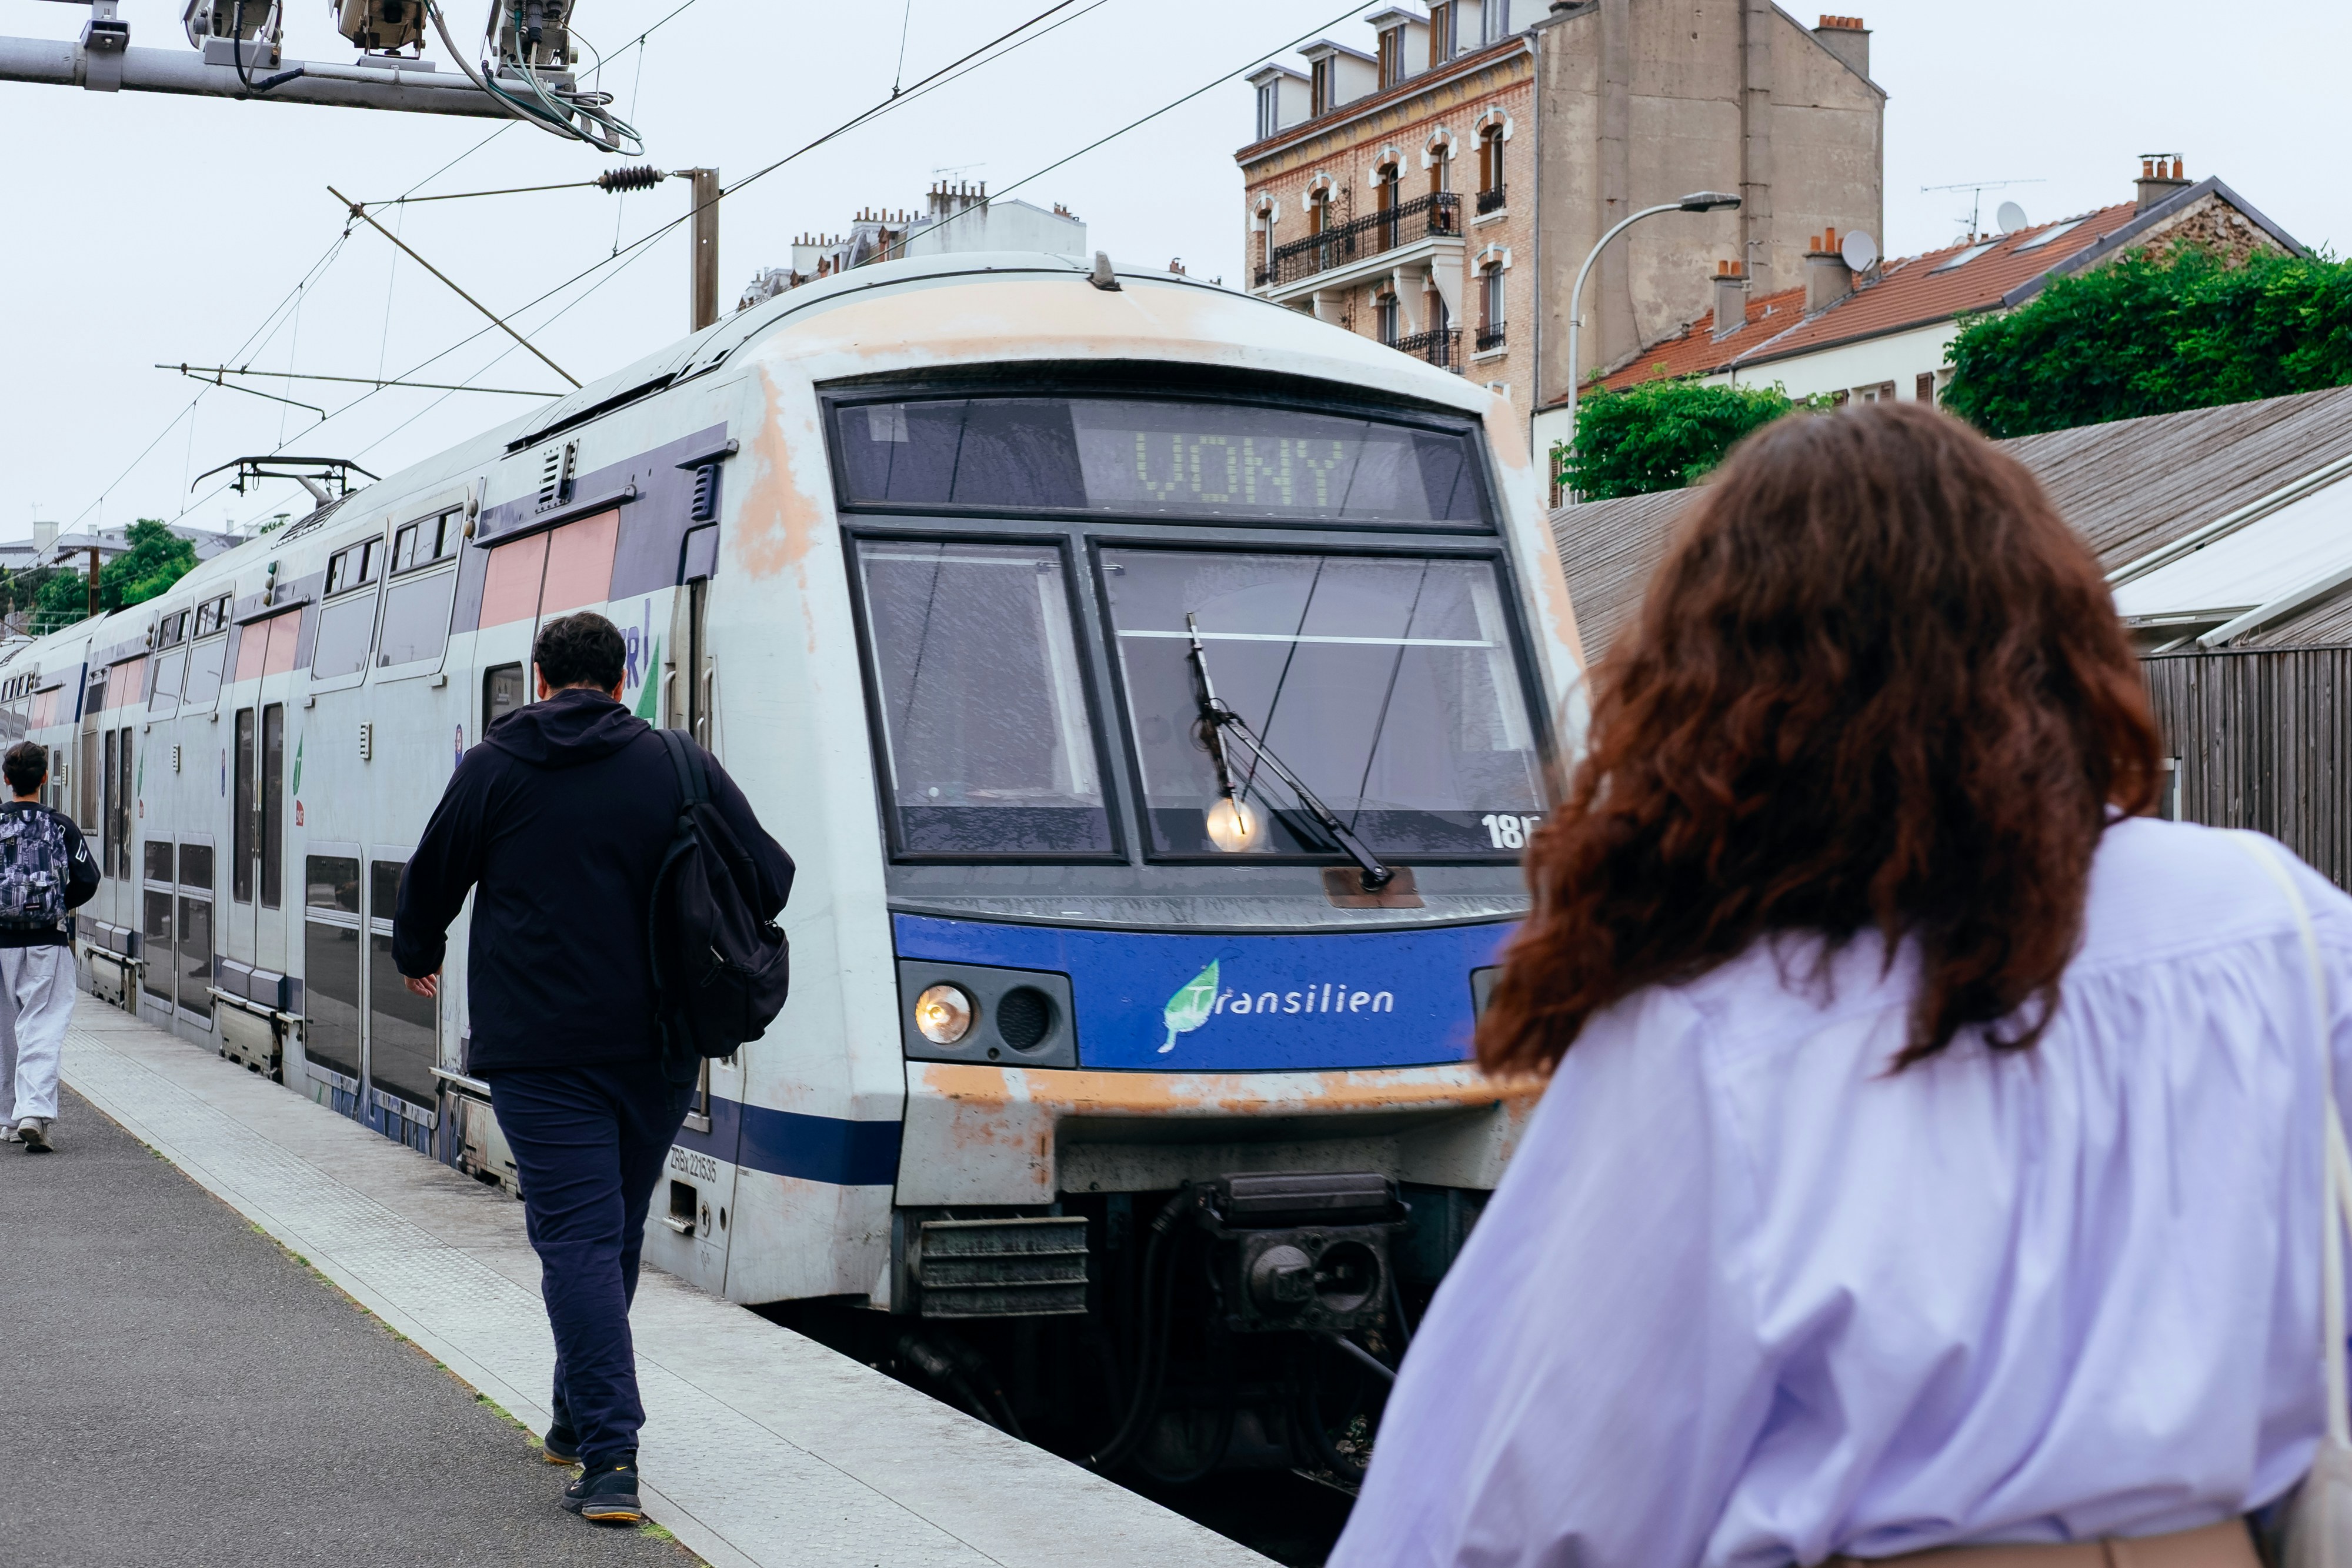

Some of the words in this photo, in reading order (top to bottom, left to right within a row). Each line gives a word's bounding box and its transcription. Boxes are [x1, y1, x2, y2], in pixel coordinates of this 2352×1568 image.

[1136, 432, 1344, 507] VONY
[1186, 983, 1394, 1015] Transilien
[689, 1153, 716, 1183] 221535
